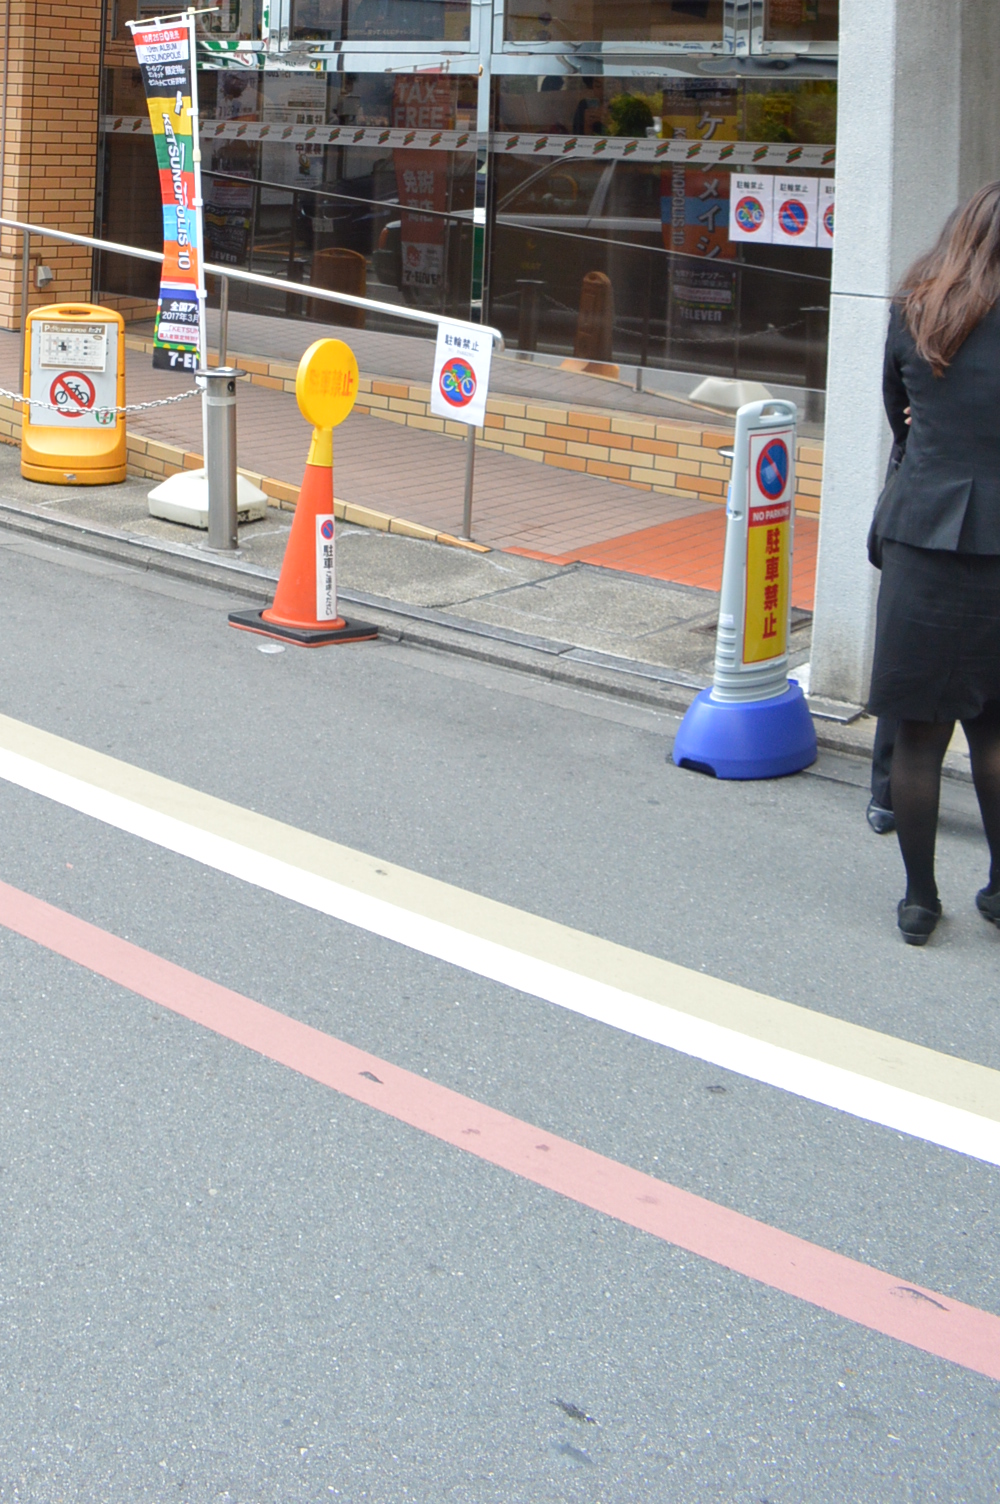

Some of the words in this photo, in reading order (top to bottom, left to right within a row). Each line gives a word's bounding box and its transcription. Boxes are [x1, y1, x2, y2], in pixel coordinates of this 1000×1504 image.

[444, 333, 480, 352] 駐輪禁止
[752, 510, 765, 523] NO
[765, 506, 790, 521] PARKING
[762, 527, 781, 639] 駐車禁止
